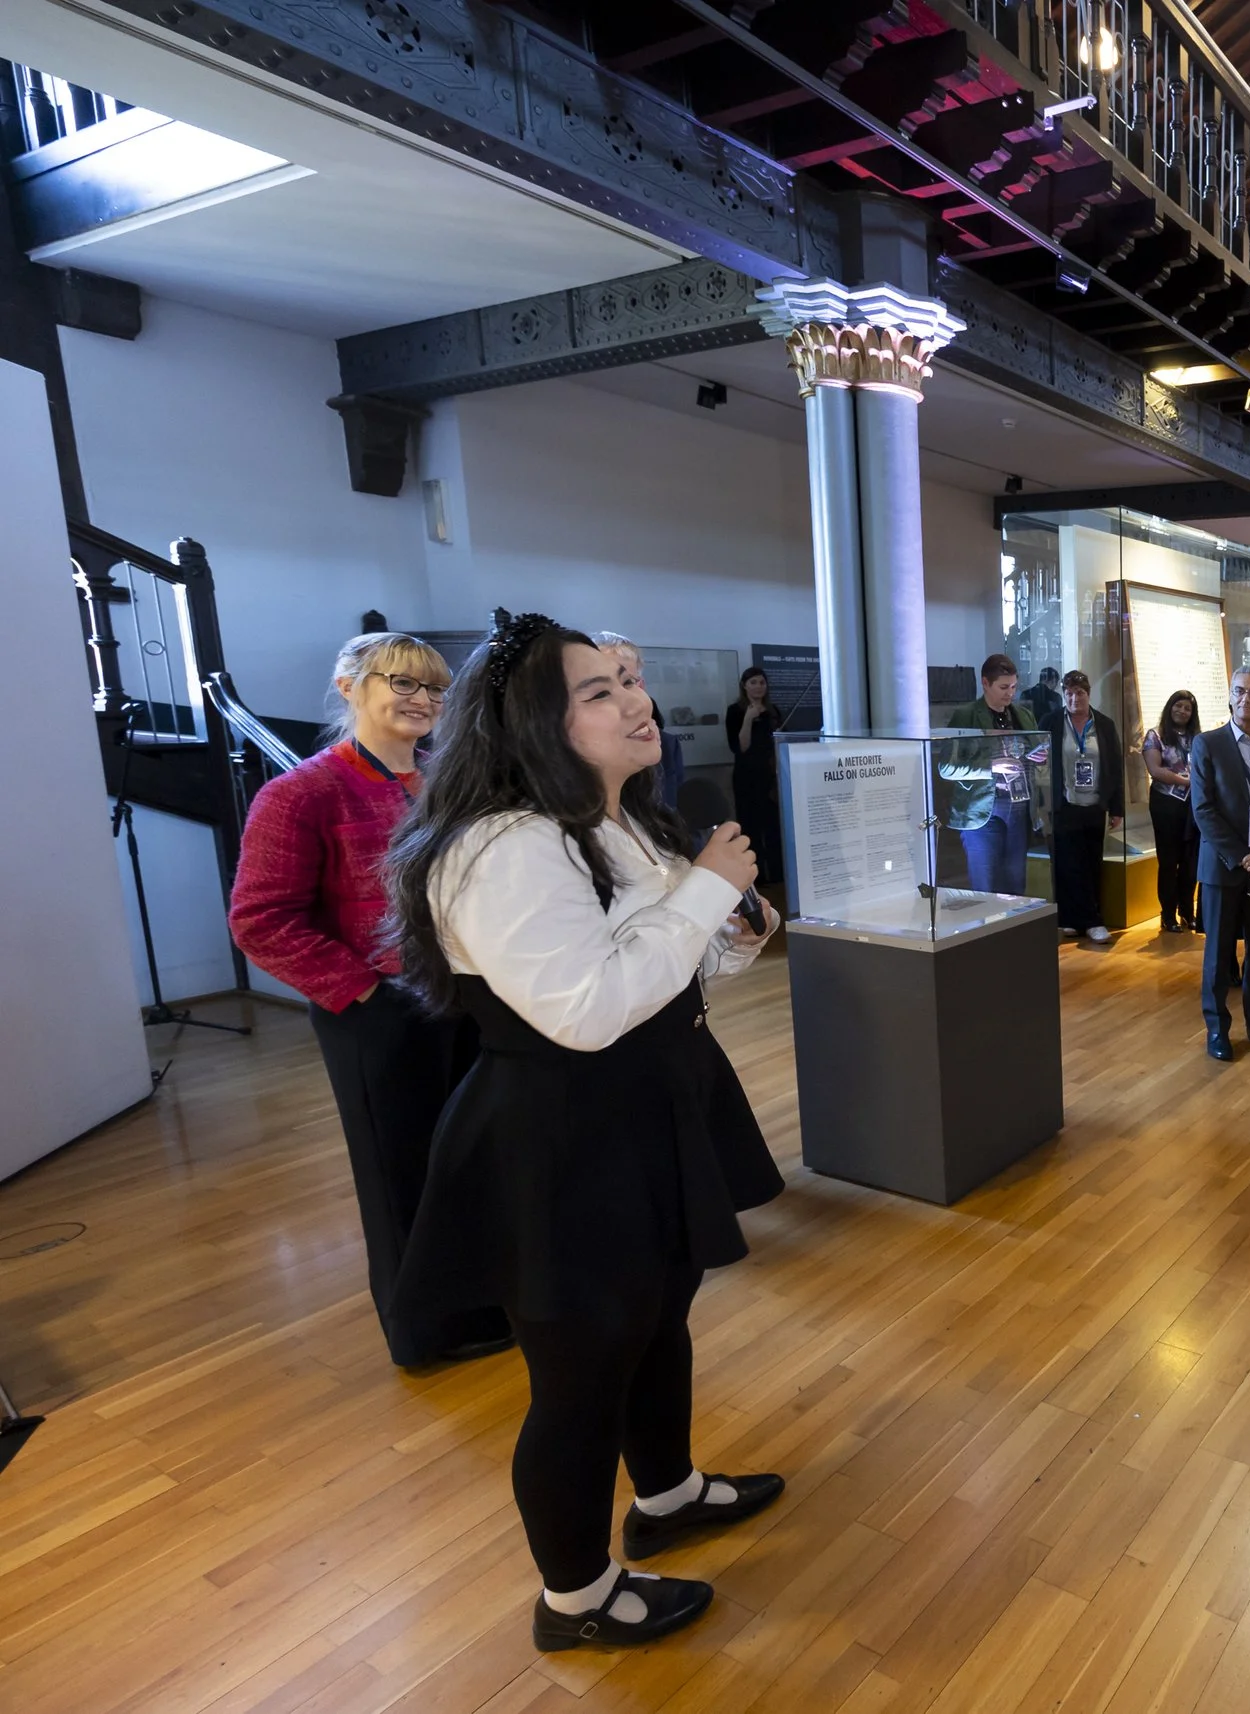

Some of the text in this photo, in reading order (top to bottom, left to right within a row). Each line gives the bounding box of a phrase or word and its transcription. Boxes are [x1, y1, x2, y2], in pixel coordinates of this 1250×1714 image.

[837, 754, 883, 768] A METEORITE
[824, 766, 896, 782] FALLS ON GLASGOW!
